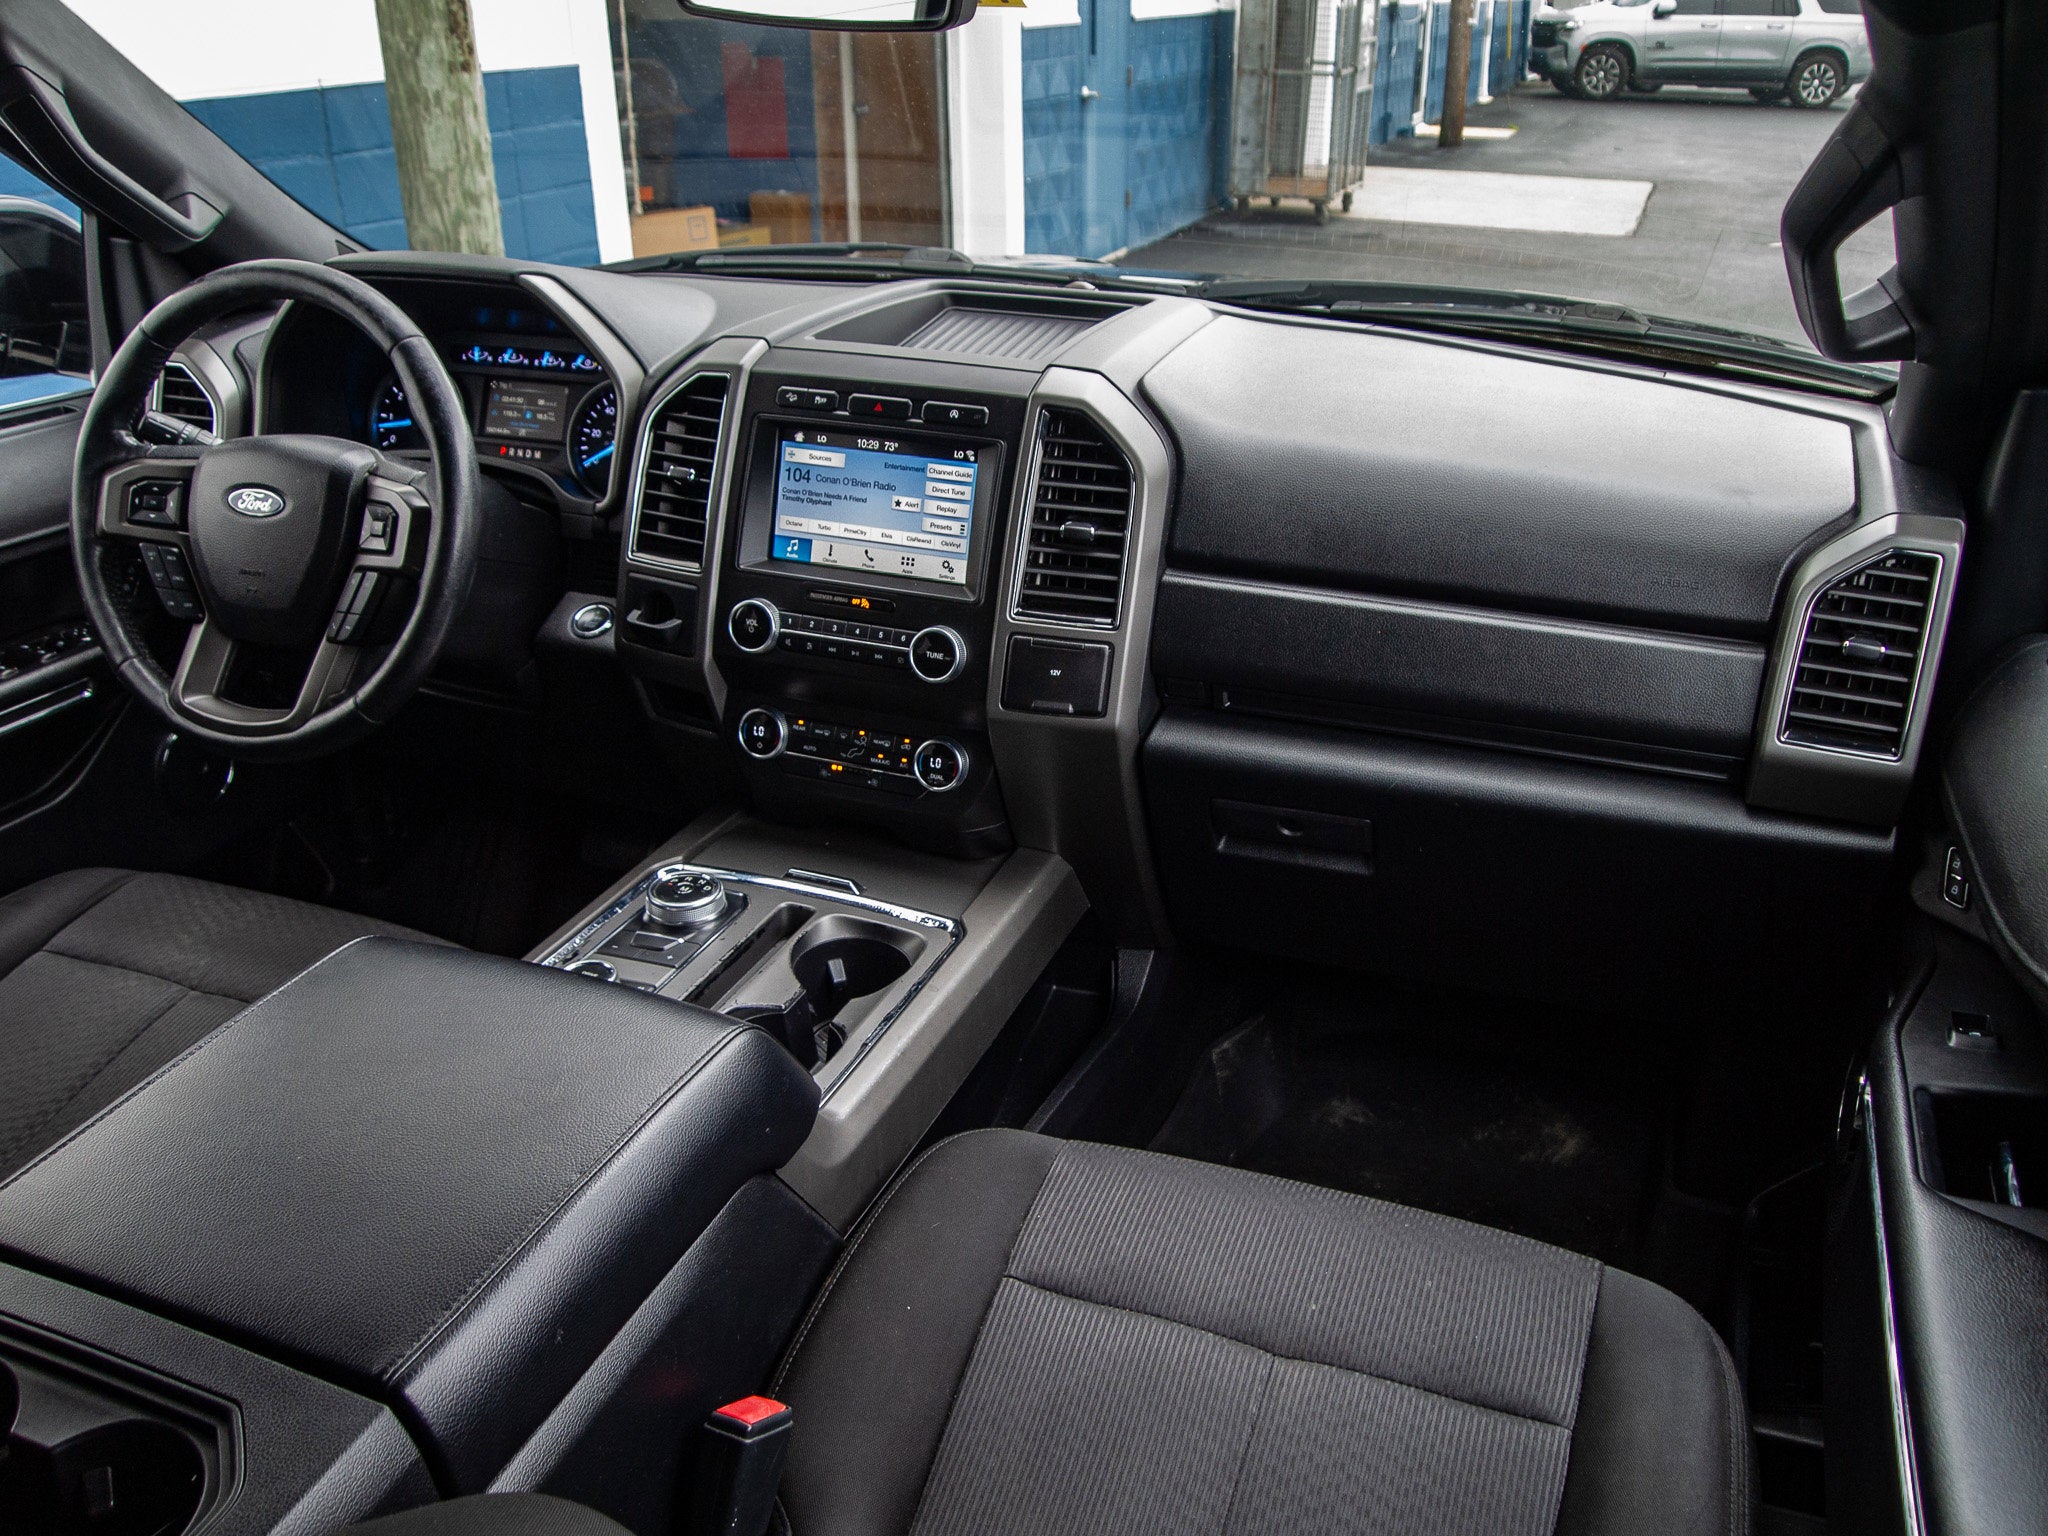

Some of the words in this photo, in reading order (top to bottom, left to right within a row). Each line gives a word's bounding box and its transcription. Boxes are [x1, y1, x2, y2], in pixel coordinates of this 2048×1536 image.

[604, 406, 615, 416] 40
[591, 428, 602, 438] 20
[389, 434, 396, 443] 0
[817, 434, 827, 443] LO
[857, 438, 879, 449] 10:29
[808, 453, 832, 462] Sources
[953, 450, 964, 459] LO
[884, 462, 925, 474] Entertainment
[928, 467, 953, 476] Channel
[954, 470, 972, 479] Guide
[785, 466, 811, 483] 104
[815, 474, 840, 485] Conan
[842, 477, 871, 489] O'Brien
[873, 480, 896, 492] Radio
[782, 487, 801, 496] Conan
[802, 488, 823, 498] O'Brien
[824, 491, 842, 500] Needs
[849, 494, 867, 504] Friend
[931, 486, 949, 494] Direct
[951, 487, 965, 496] Tune
[237, 491, 273, 512] Ford
[781, 494, 805, 504] Timothy
[805, 496, 832, 507] Olyphant
[904, 501, 919, 509] Alert
[936, 505, 957, 515] Replay
[785, 519, 803, 527] Octane
[817, 523, 831, 531] Turbo
[929, 521, 952, 531] Presets
[1651, 577, 1700, 590] AIRBAG
[745, 618, 759, 627] VOL
[926, 650, 944, 660] TUNE
[1050, 669, 1062, 677] 12V
[753, 725, 765, 737] LO
[803, 744, 817, 752] AUTO
[929, 756, 942, 769] LO
[930, 773, 944, 781] DUAL
